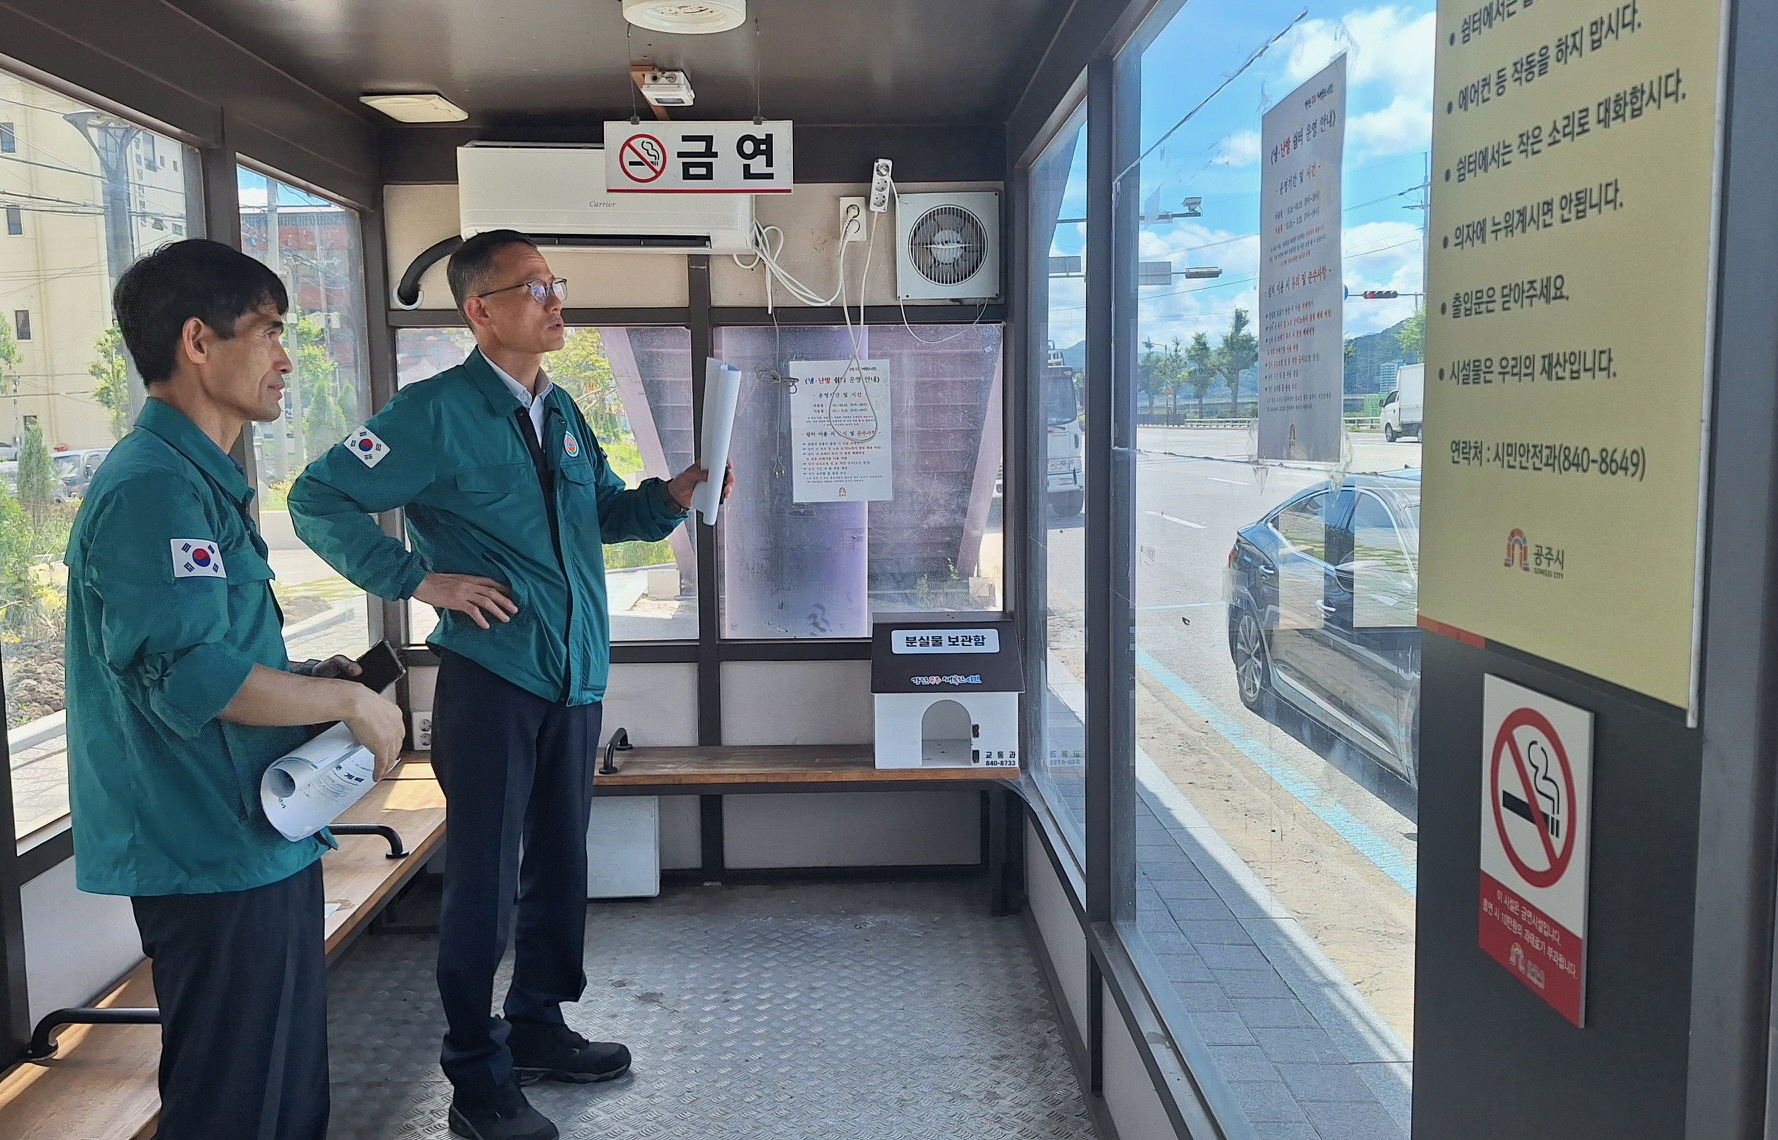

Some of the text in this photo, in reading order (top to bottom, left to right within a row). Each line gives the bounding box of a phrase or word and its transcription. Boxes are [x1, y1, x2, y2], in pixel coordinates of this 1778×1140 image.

[1458, 0, 1642, 112] 에어컨 등 작동을 하지 맙시다.
[1456, 68, 1686, 183] 쉼터에서는 작은 소리로 대화합시다.
[589, 200, 616, 208] Carrier
[1454, 178, 1624, 250] 의자에 누워계시면 안됩니다.
[1452, 274, 1570, 319] 출입문은 닫아주세요.
[1450, 348, 1617, 385] 시설물은 우리의 재산입니다.
[1450, 439, 1484, 467] 연락처
[1493, 442, 1647, 482] 시민안전과(840-8649)
[1533, 544, 1565, 570] 공주시
[905, 635, 986, 647] 분실물 보관함
[1494, 908, 1500, 921] 시
[1497, 890, 1503, 904] 이
[1505, 895, 1521, 916] 시설은
